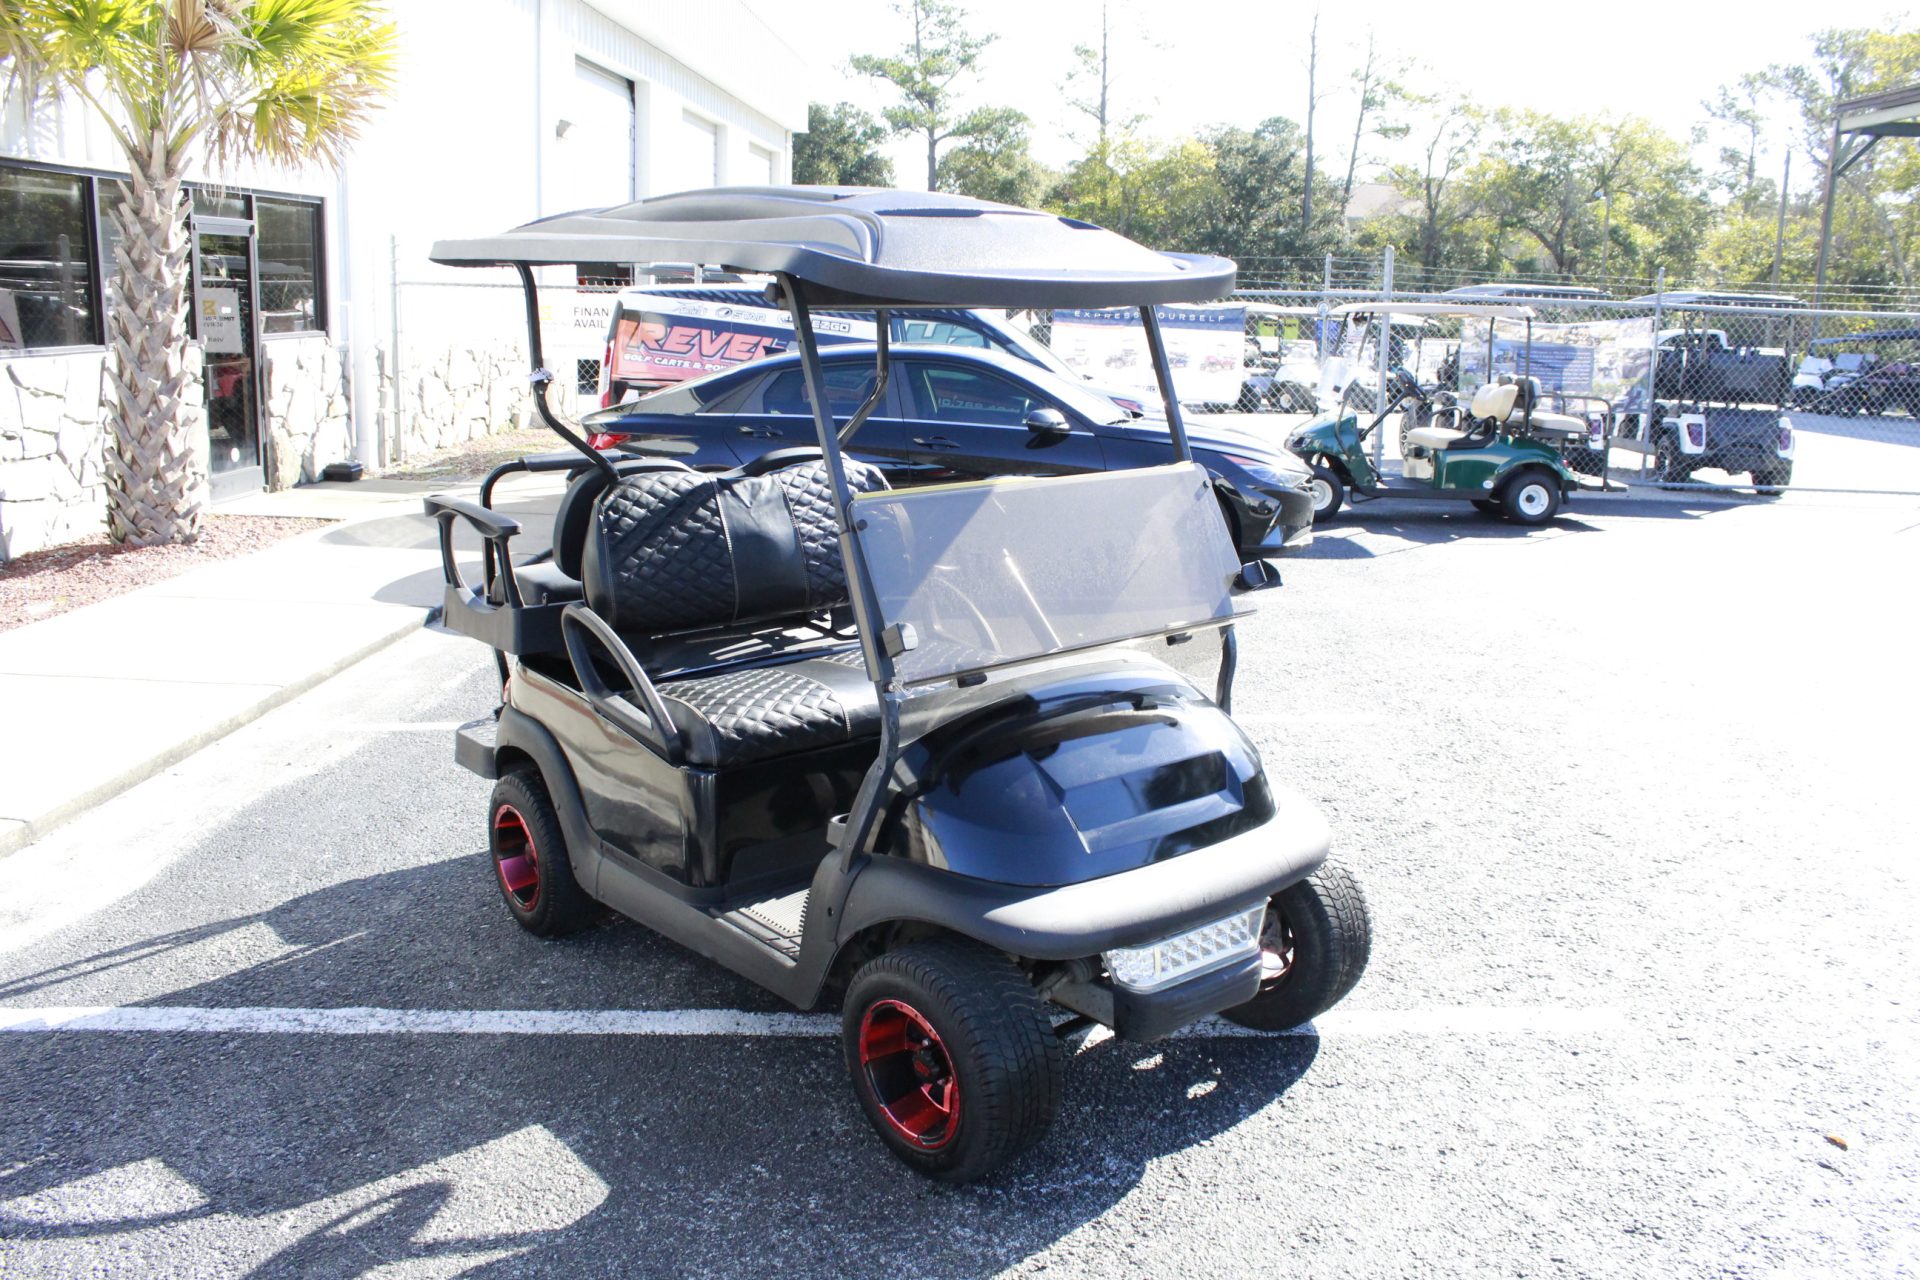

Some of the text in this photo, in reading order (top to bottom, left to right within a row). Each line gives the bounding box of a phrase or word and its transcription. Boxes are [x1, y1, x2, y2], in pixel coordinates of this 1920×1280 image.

[573, 306, 610, 317] FINAN
[1073, 310, 1225, 322] EXPRESS OURSELF
[573, 318, 607, 329] AVAIL
[623, 353, 652, 362] GOLF
[654, 356, 691, 368] CARTS
